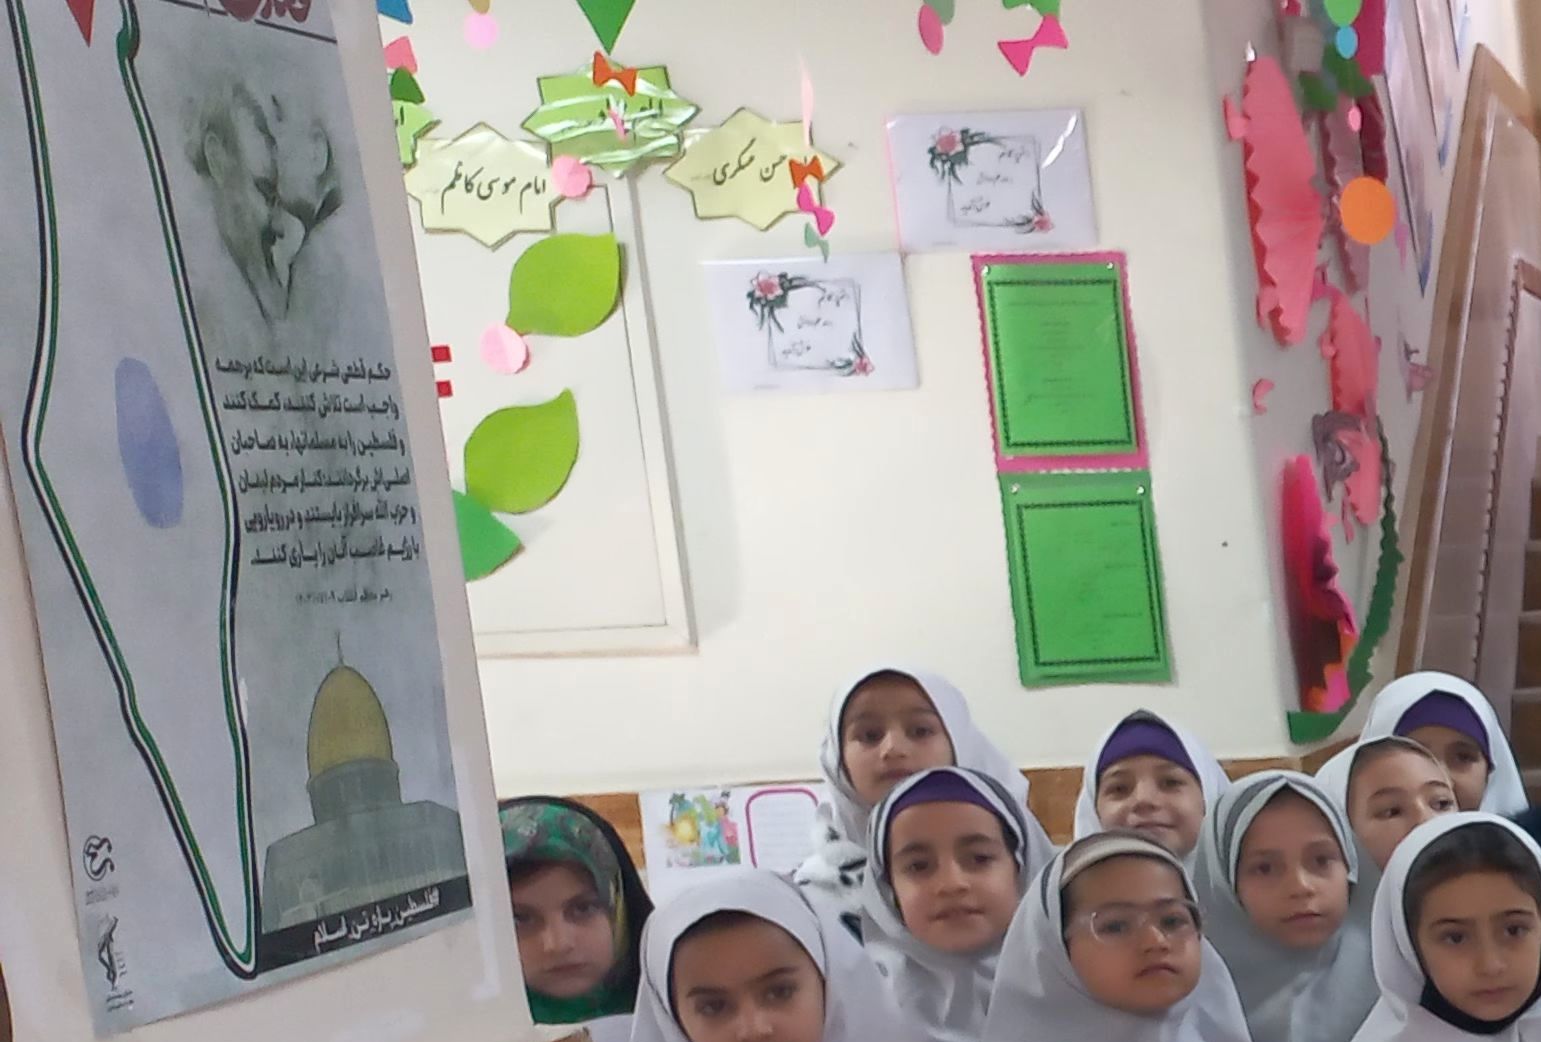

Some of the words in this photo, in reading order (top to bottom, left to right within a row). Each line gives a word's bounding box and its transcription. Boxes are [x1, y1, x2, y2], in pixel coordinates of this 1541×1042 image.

[712, 137, 756, 186] عسکری
[760, 153, 788, 182] حسن
[441, 160, 483, 215] کاظم
[477, 173, 511, 199] موسی
[519, 178, 546, 215] امام
[215, 357, 241, 374] همه
[252, 356, 265, 375] که
[266, 355, 291, 376] است
[292, 356, 308, 381] این
[309, 360, 340, 383] شرعی
[342, 358, 366, 385] قطعی
[368, 362, 391, 384] حکم
[222, 390, 247, 411] کنند
[248, 391, 281, 411] کمک
[318, 392, 342, 418] تلاش
[343, 393, 366, 413] است
[366, 394, 400, 420] واجب
[230, 428, 276, 455] صاحبان
[278, 434, 290, 456] به
[338, 434, 347, 452] به
[346, 430, 356, 456] را
[356, 427, 398, 457] فلسطین
[399, 437, 406, 457] و
[238, 468, 268, 494] لبنان
[270, 473, 299, 494] مردم
[298, 511, 304, 529] و
[304, 501, 343, 528] بایستند
[343, 500, 374, 527] سرافراز
[374, 498, 388, 521] الله
[390, 503, 409, 526] حزب
[411, 506, 417, 525] و
[289, 540, 318, 569] یاری
[317, 541, 327, 568] را
[328, 535, 349, 565] آنان
[314, 914, 348, 954] اسلام
